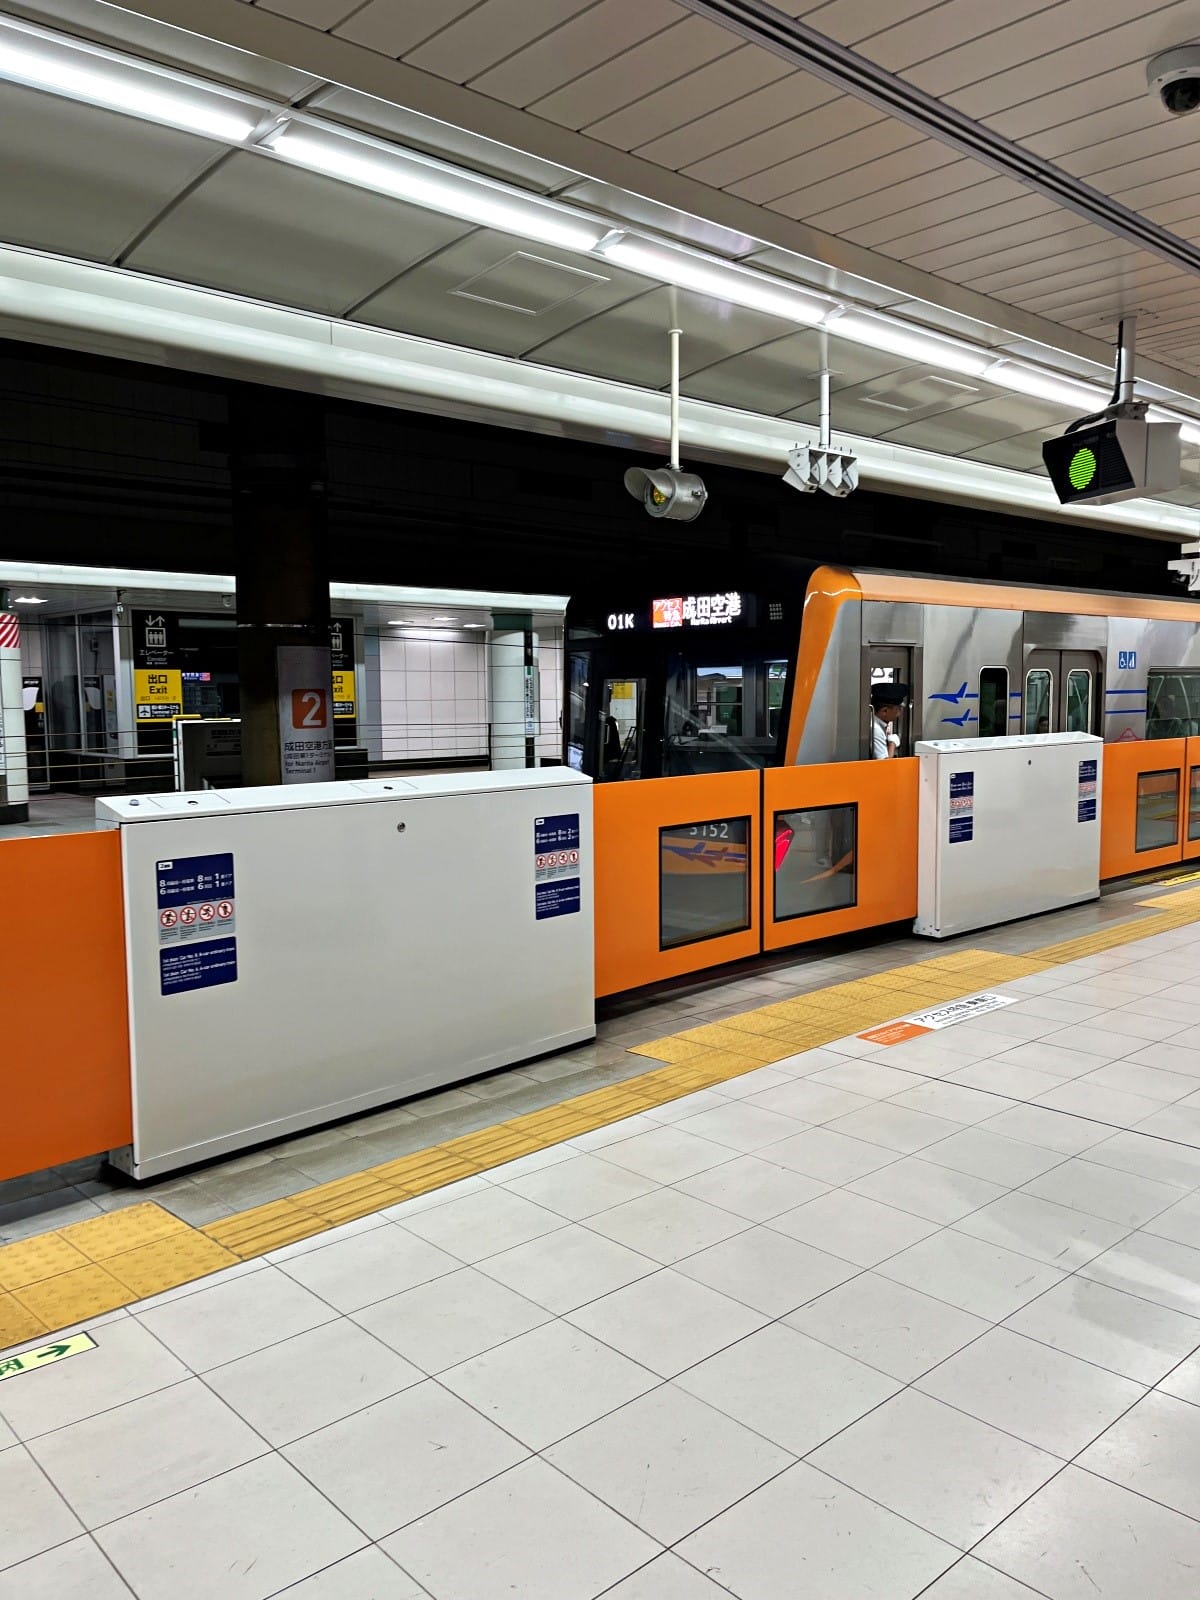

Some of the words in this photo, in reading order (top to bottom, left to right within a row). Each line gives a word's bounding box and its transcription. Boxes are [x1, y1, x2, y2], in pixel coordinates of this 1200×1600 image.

[682, 592, 741, 619] 成田空港
[607, 613, 634, 630] 01K
[148, 674, 168, 684] 出口
[149, 685, 168, 694] Exit
[302, 691, 322, 726] 2
